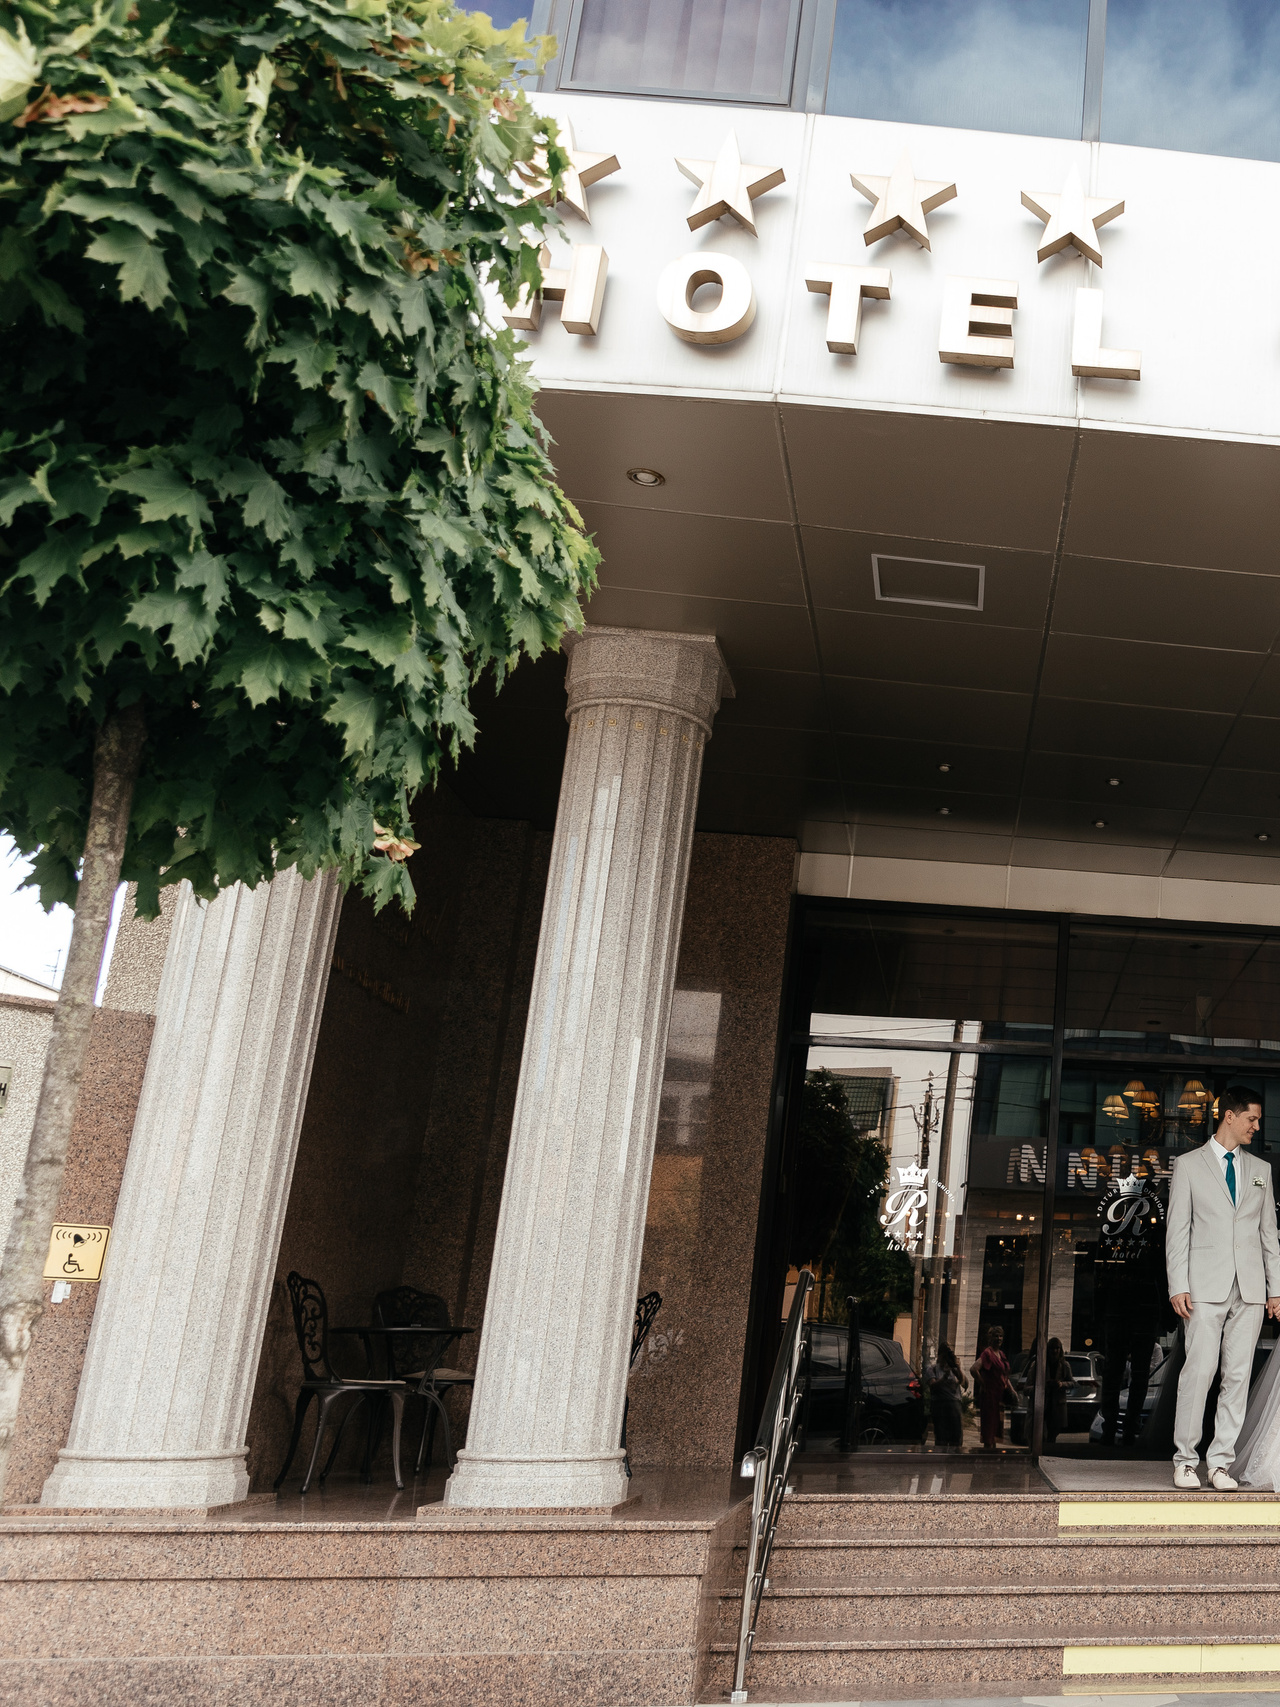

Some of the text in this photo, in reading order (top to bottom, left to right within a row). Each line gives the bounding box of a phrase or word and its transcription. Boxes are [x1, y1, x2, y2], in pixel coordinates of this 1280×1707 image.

[502, 241, 1142, 381] HOTEL
[880, 1189, 928, 1227] R
[1097, 1188, 1118, 1211] DETUR
[1102, 1196, 1150, 1236] R
[887, 1240, 919, 1251] hotel
[1112, 1248, 1142, 1259] hotel
